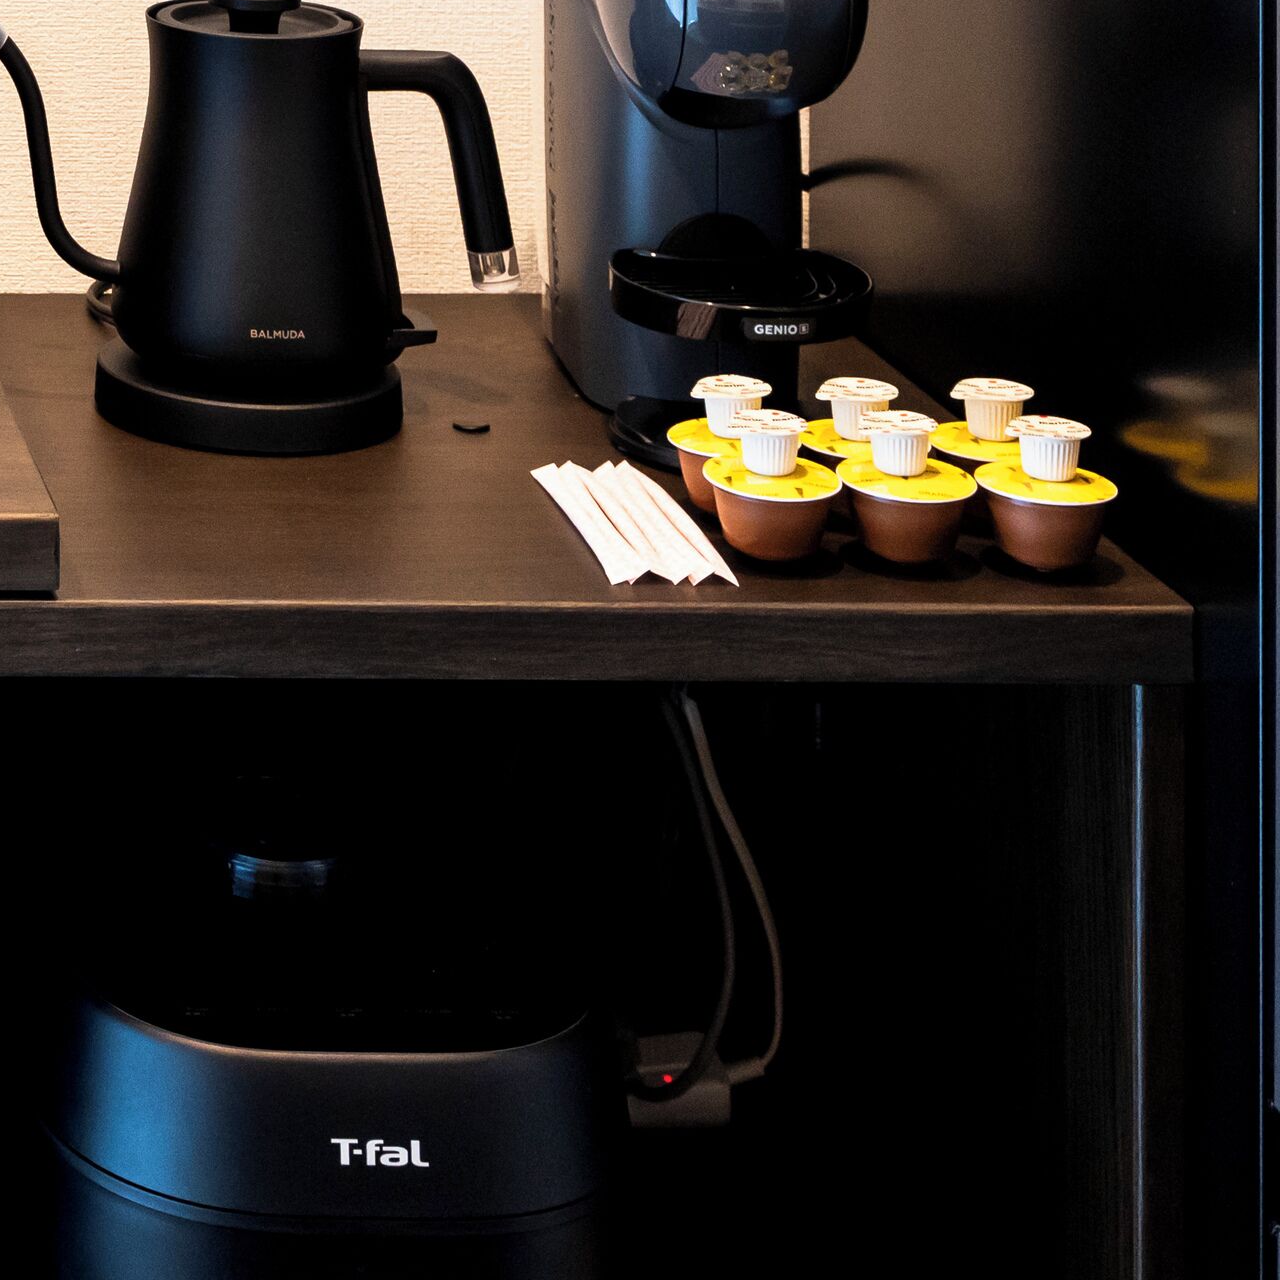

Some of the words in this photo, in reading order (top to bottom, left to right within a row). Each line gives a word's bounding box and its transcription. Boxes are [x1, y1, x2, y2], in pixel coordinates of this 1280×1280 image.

[250, 328, 306, 340] BALMUDA
[754, 324, 798, 335] GENIO
[330, 1138, 430, 1168] T-fal
